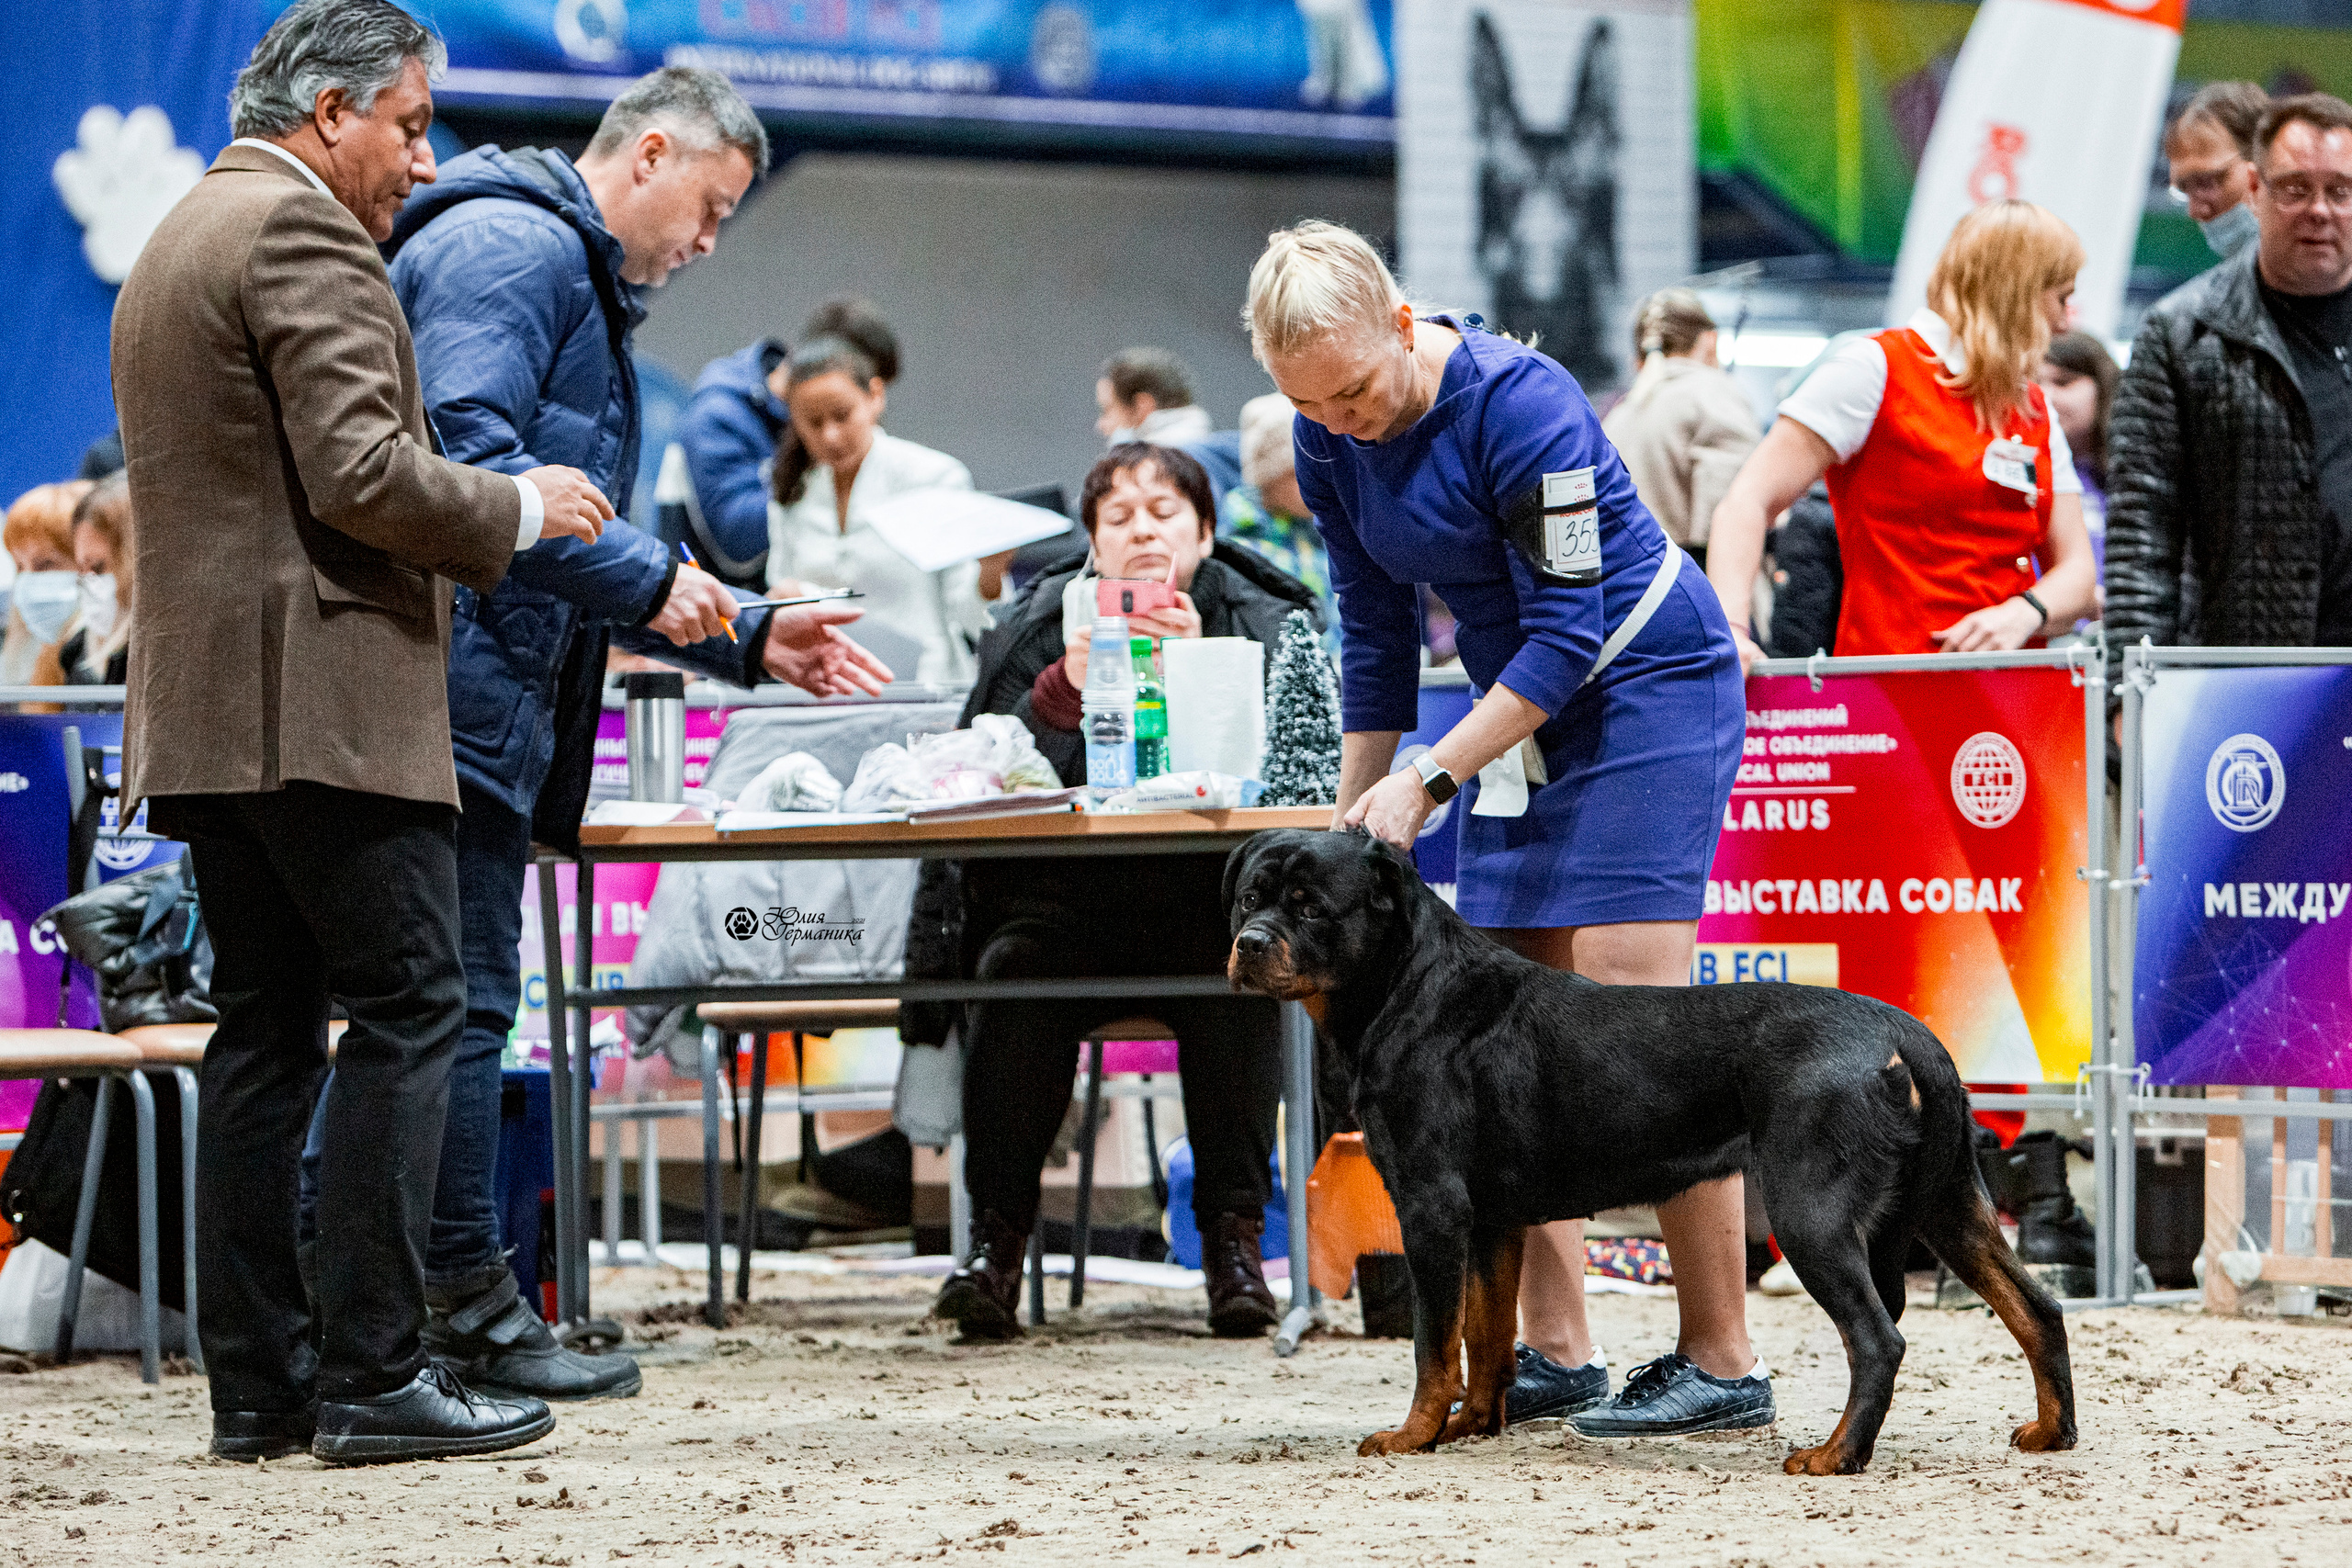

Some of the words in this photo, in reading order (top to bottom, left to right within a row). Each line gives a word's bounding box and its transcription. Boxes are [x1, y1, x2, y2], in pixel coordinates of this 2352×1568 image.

[1776, 761, 1830, 782] UNION
[1724, 798, 1831, 830] LARUS
[1702, 878, 1890, 915] ВЫСТАВКА
[1899, 876, 2023, 914] СОБАК
[2204, 882, 2352, 924] МЕЖДУ
[29, 919, 69, 955] С
[1733, 950, 1788, 984] FCI
